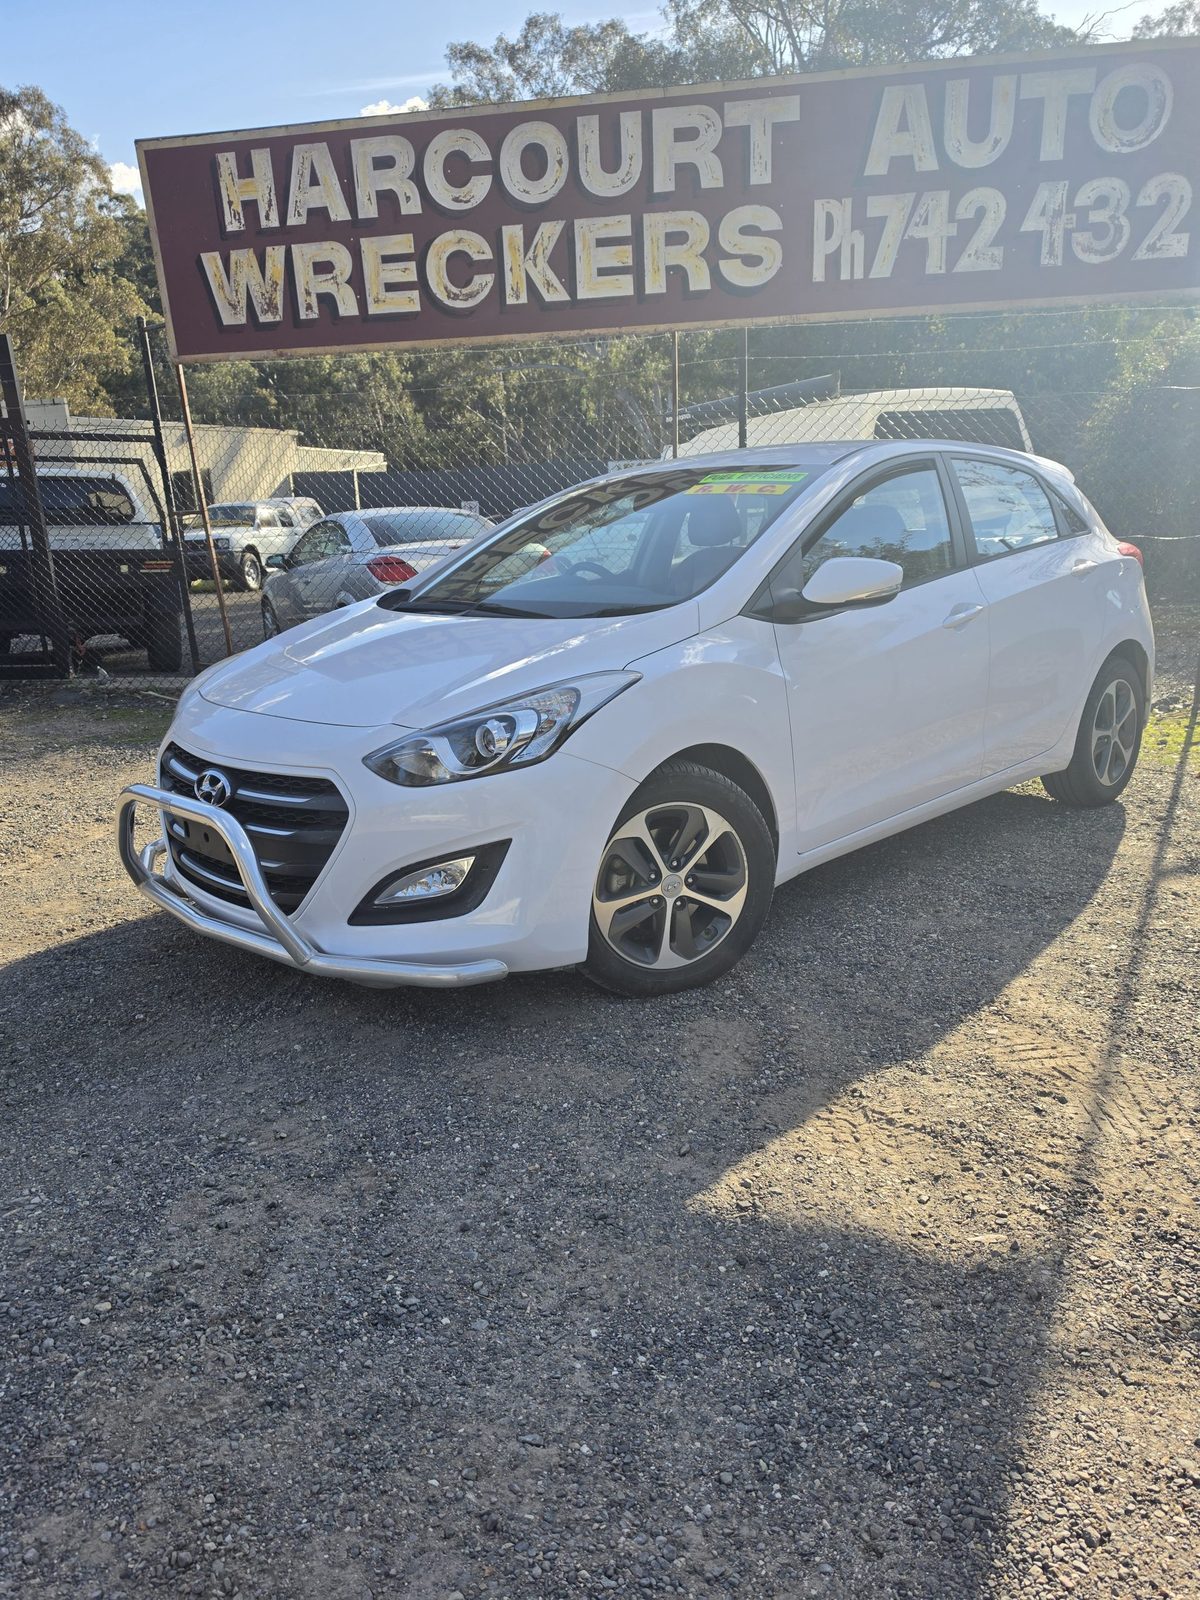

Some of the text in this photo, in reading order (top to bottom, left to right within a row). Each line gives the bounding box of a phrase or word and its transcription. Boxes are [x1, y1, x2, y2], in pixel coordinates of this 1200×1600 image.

[215, 62, 1174, 233] HARCOURT AUTO
[200, 204, 783, 326] WRECKERS
